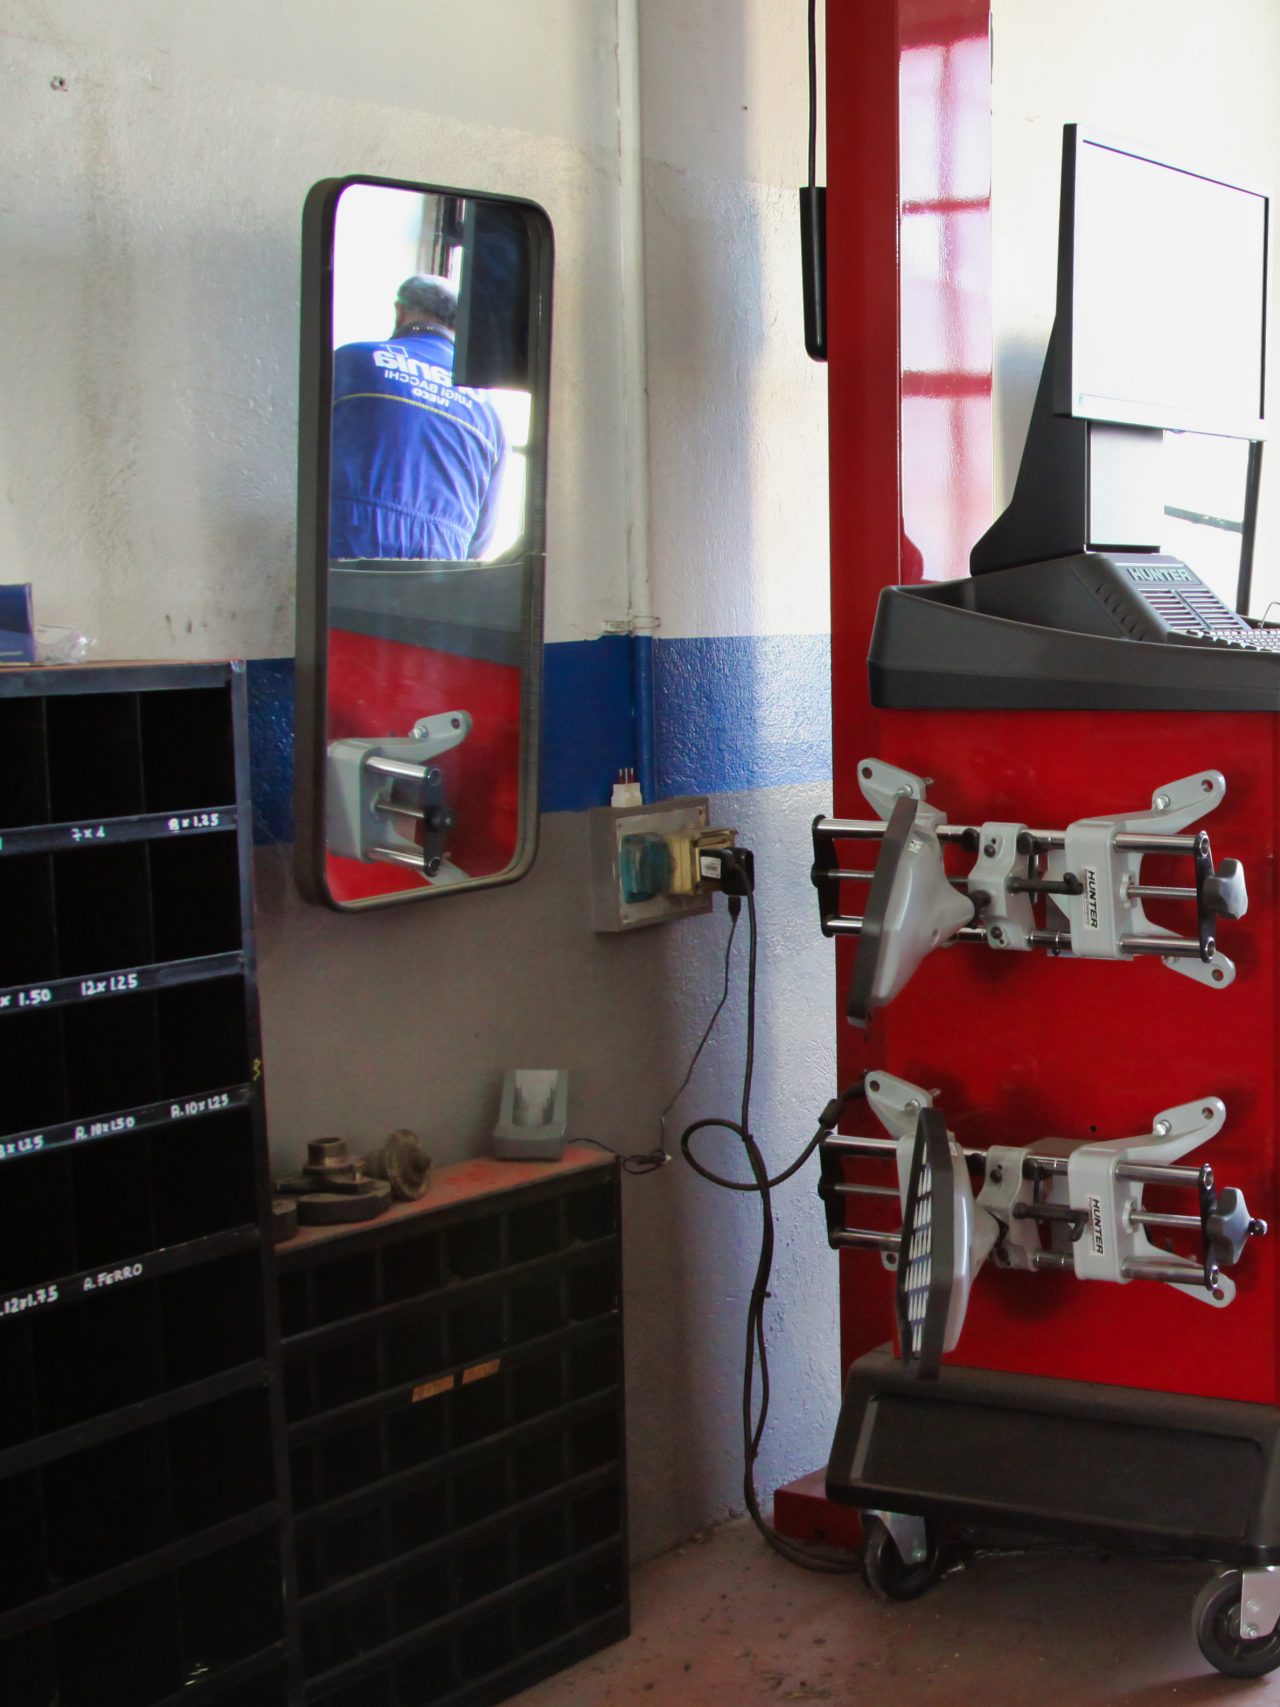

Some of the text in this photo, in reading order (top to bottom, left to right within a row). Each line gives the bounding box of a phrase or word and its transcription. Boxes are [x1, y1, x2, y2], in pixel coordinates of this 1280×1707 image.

[1127, 567, 1192, 581] HUNTER
[1088, 870, 1098, 928] HUNTER
[1093, 1198, 1103, 1254] HUNTER
